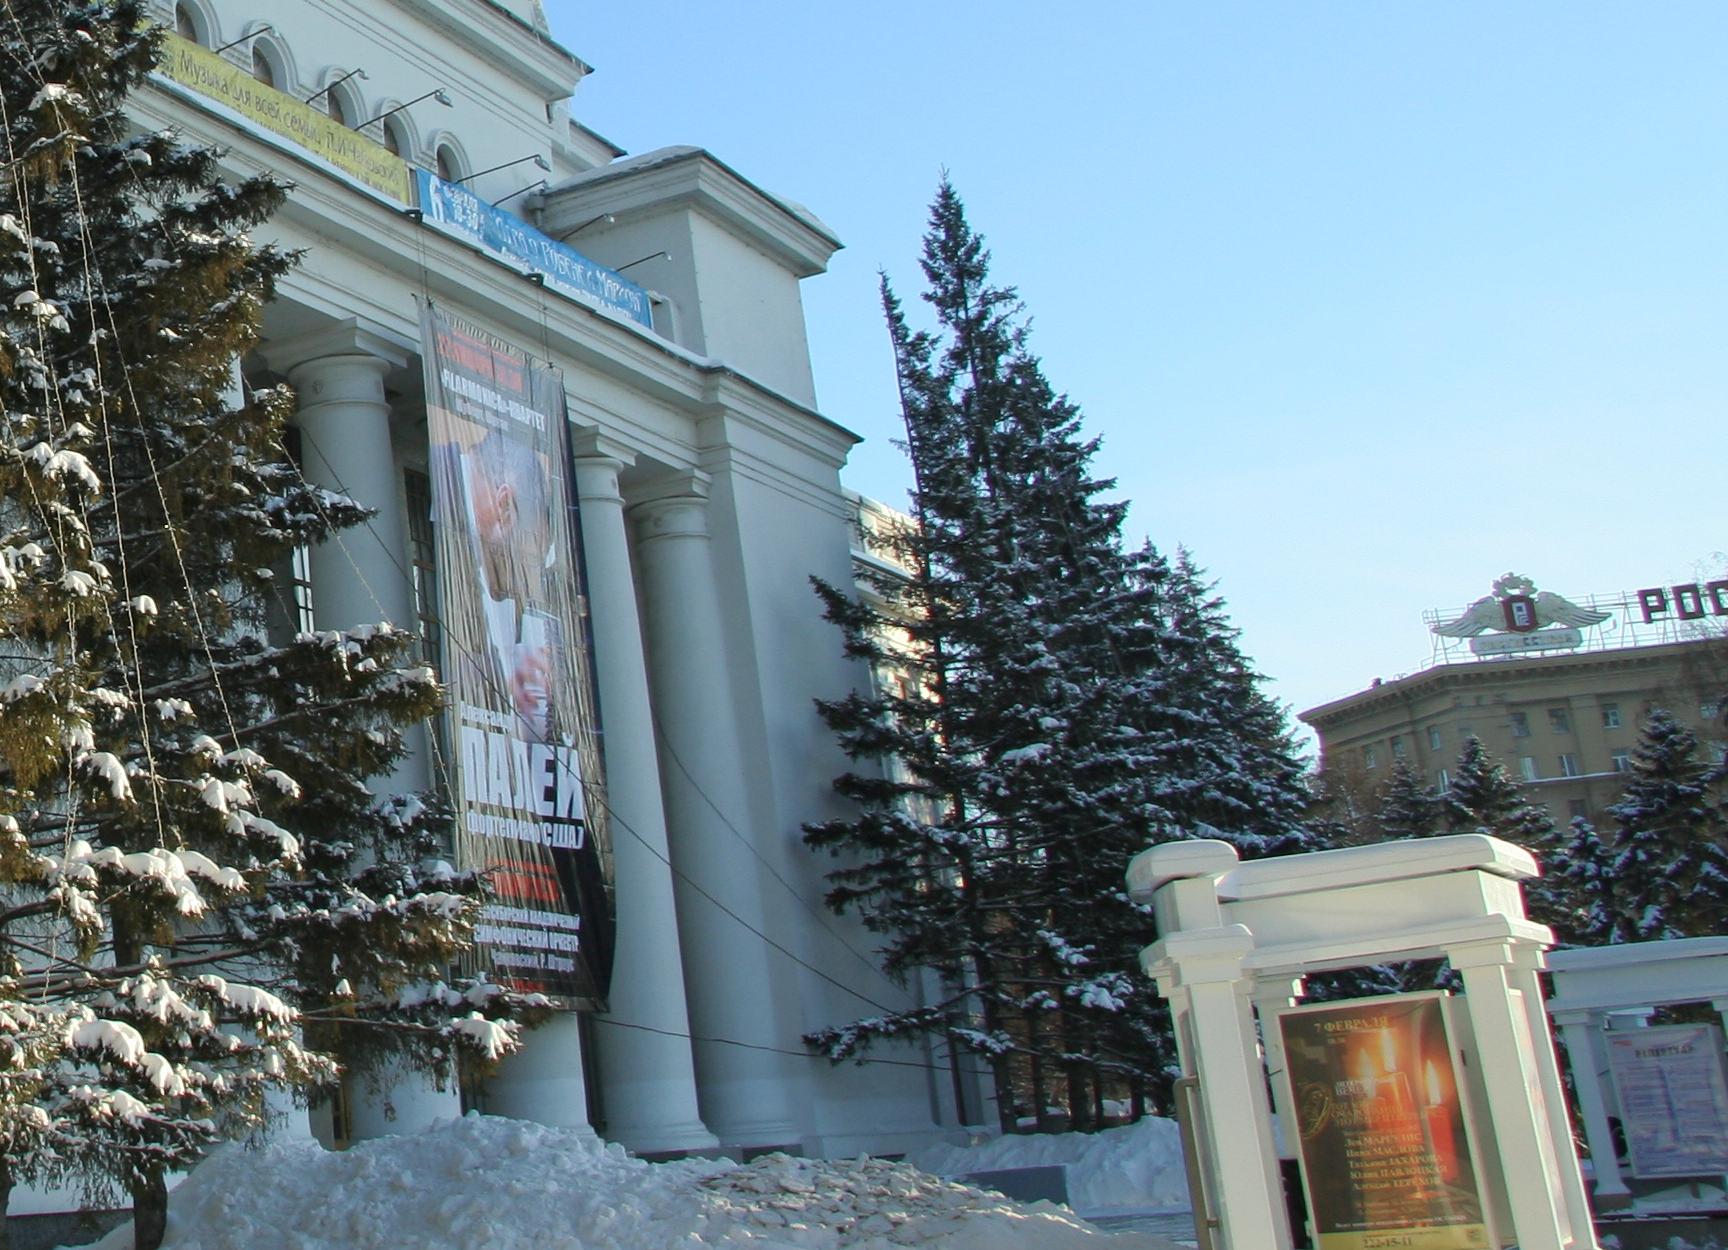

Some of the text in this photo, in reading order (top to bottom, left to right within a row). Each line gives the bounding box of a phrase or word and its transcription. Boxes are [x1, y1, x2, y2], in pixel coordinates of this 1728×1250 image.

[180, 49, 228, 95] Музыка
[233, 84, 251, 106] для
[255, 92, 281, 121] всей
[1638, 580, 1728, 625] РОС
[462, 731, 584, 820] ПАЛЕЙ
[1324, 1016, 1390, 1032] ФЕВРАЛЯ
